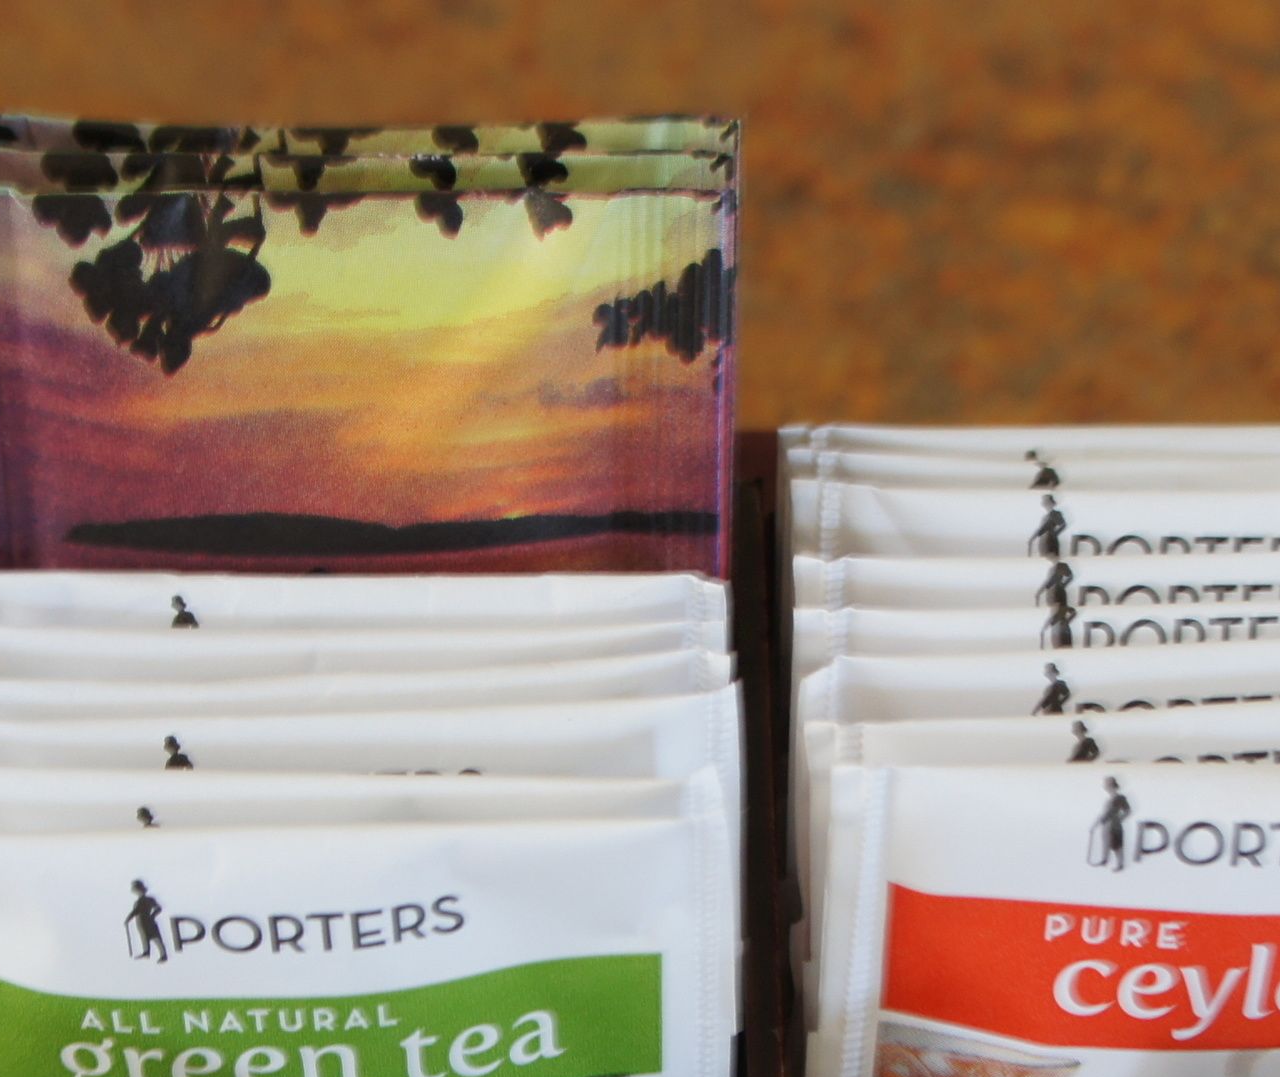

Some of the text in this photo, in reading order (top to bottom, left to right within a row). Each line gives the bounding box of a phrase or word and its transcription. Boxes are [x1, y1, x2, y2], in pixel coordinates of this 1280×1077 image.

[169, 895, 465, 953] PORTERS
[1044, 913, 1189, 949] PURE
[80, 1004, 401, 1034] ALL NATURAL
